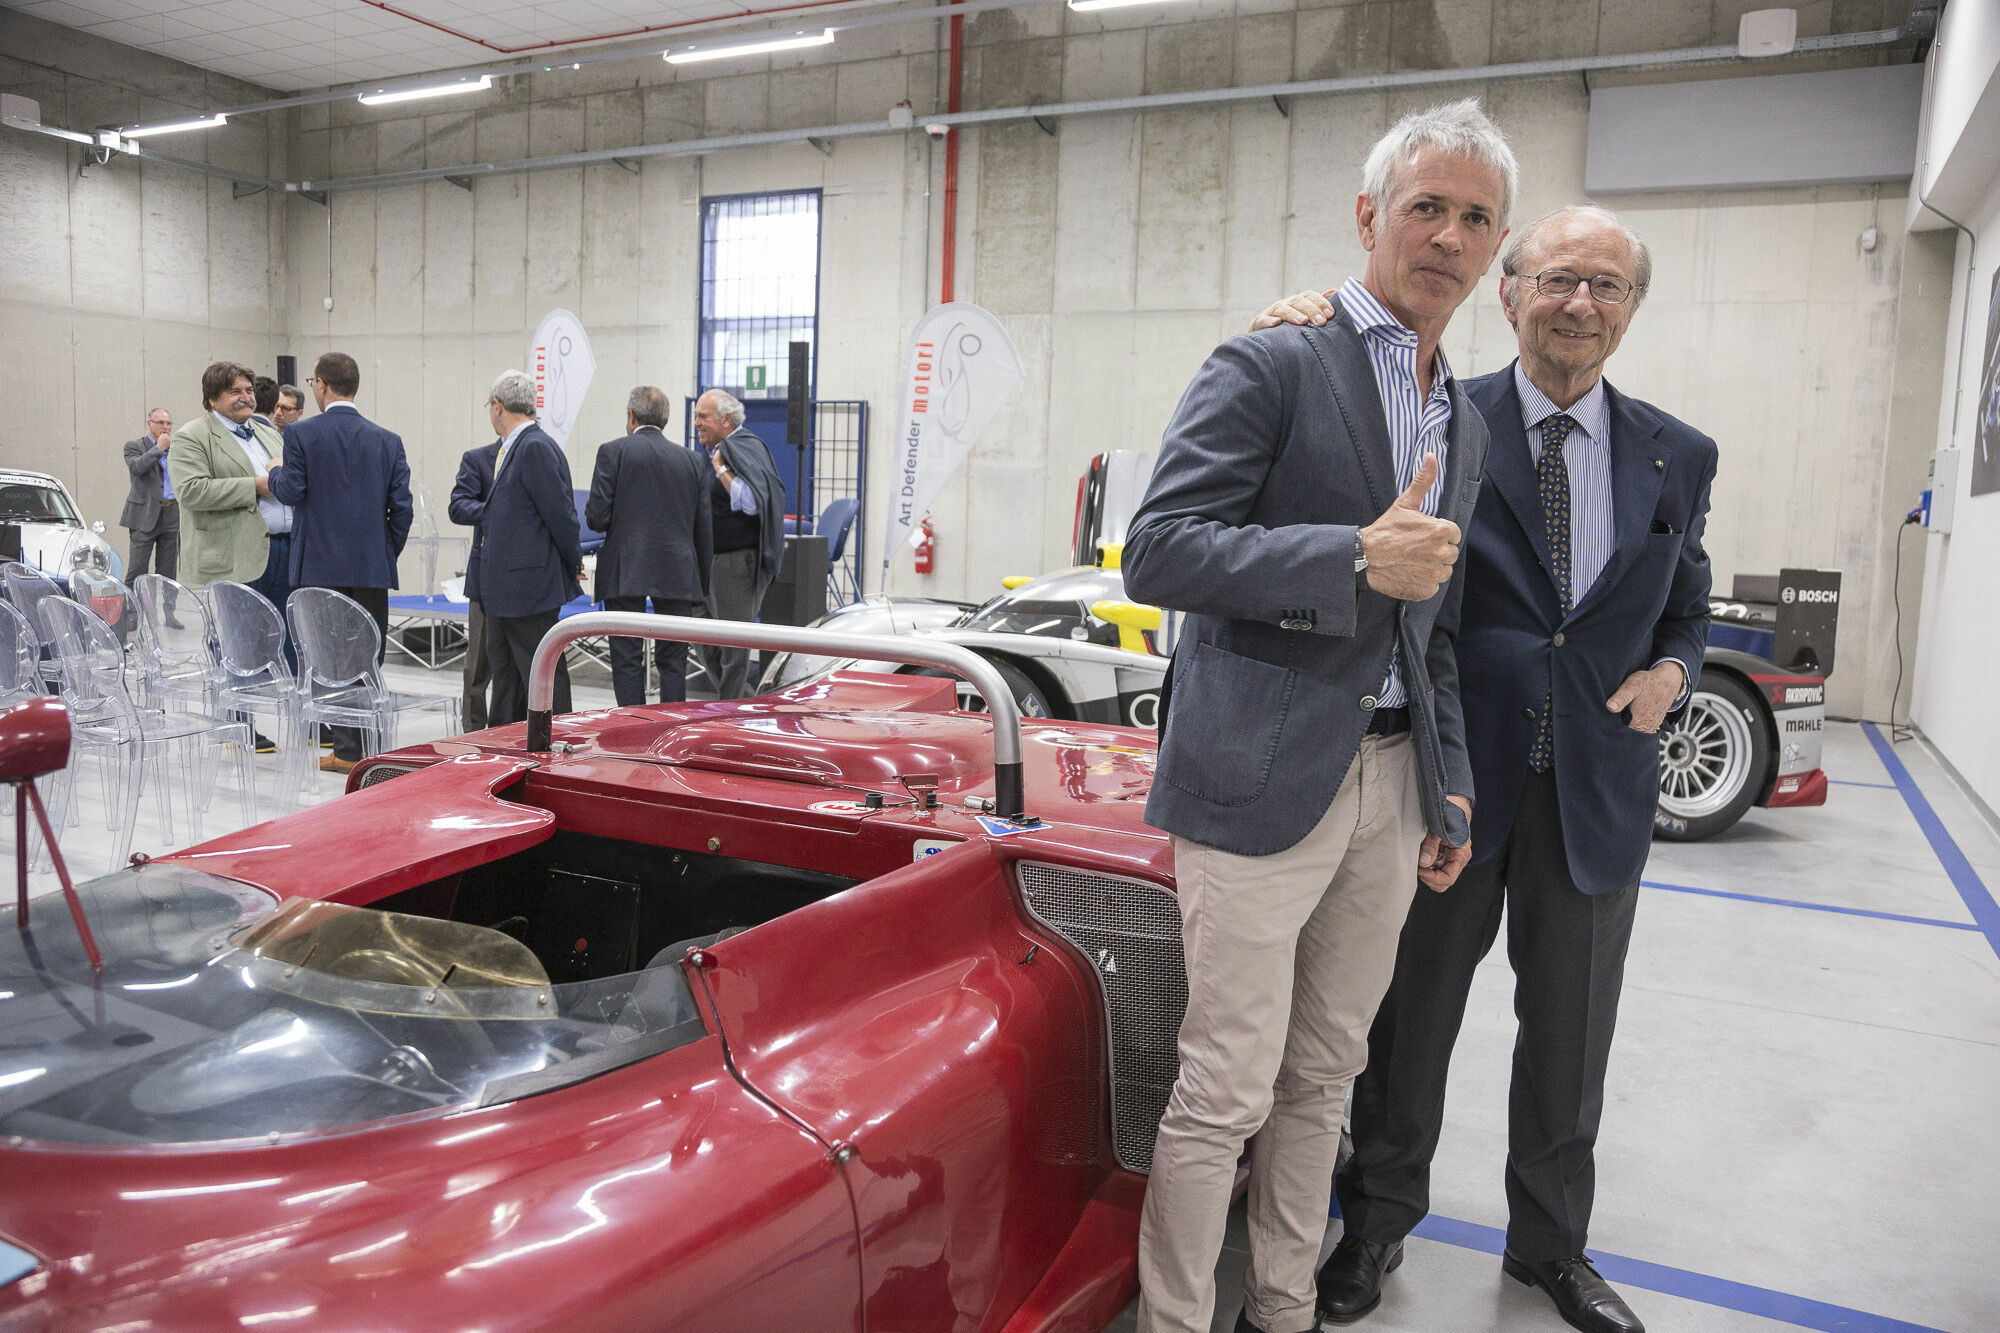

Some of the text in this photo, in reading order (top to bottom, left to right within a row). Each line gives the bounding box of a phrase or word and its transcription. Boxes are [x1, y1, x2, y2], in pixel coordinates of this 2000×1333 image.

[536, 346, 546, 408] motori
[898, 342, 934, 526] Art Defender motori
[1798, 589, 1838, 603] BOSCH
[1786, 720, 1822, 732] MAHLE
